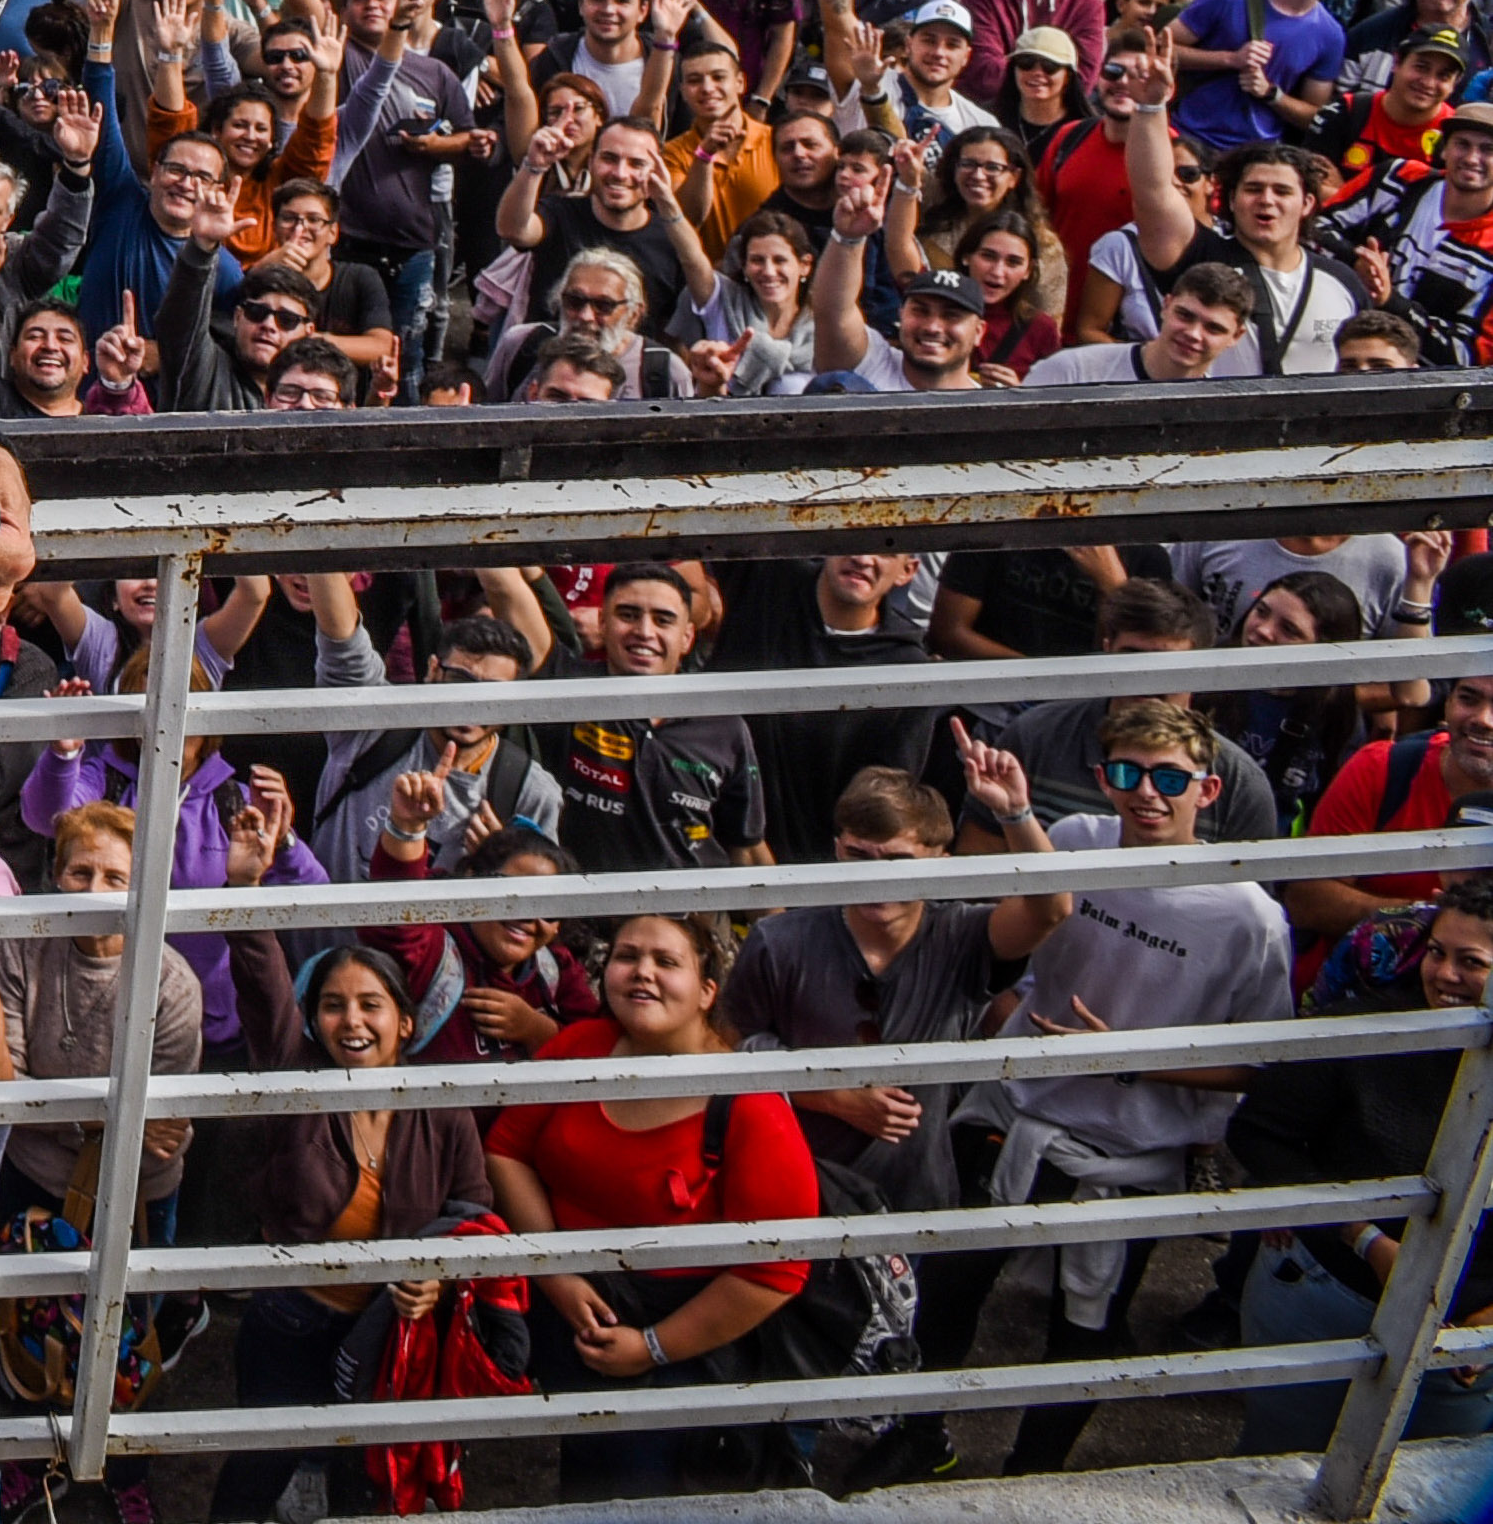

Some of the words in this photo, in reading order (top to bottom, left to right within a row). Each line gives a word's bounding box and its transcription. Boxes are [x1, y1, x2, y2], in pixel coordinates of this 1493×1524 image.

[573, 757, 625, 788] TOTAL
[586, 792, 626, 816] RUS
[1079, 898, 1121, 931] Palm
[1122, 921, 1188, 958] Angels
